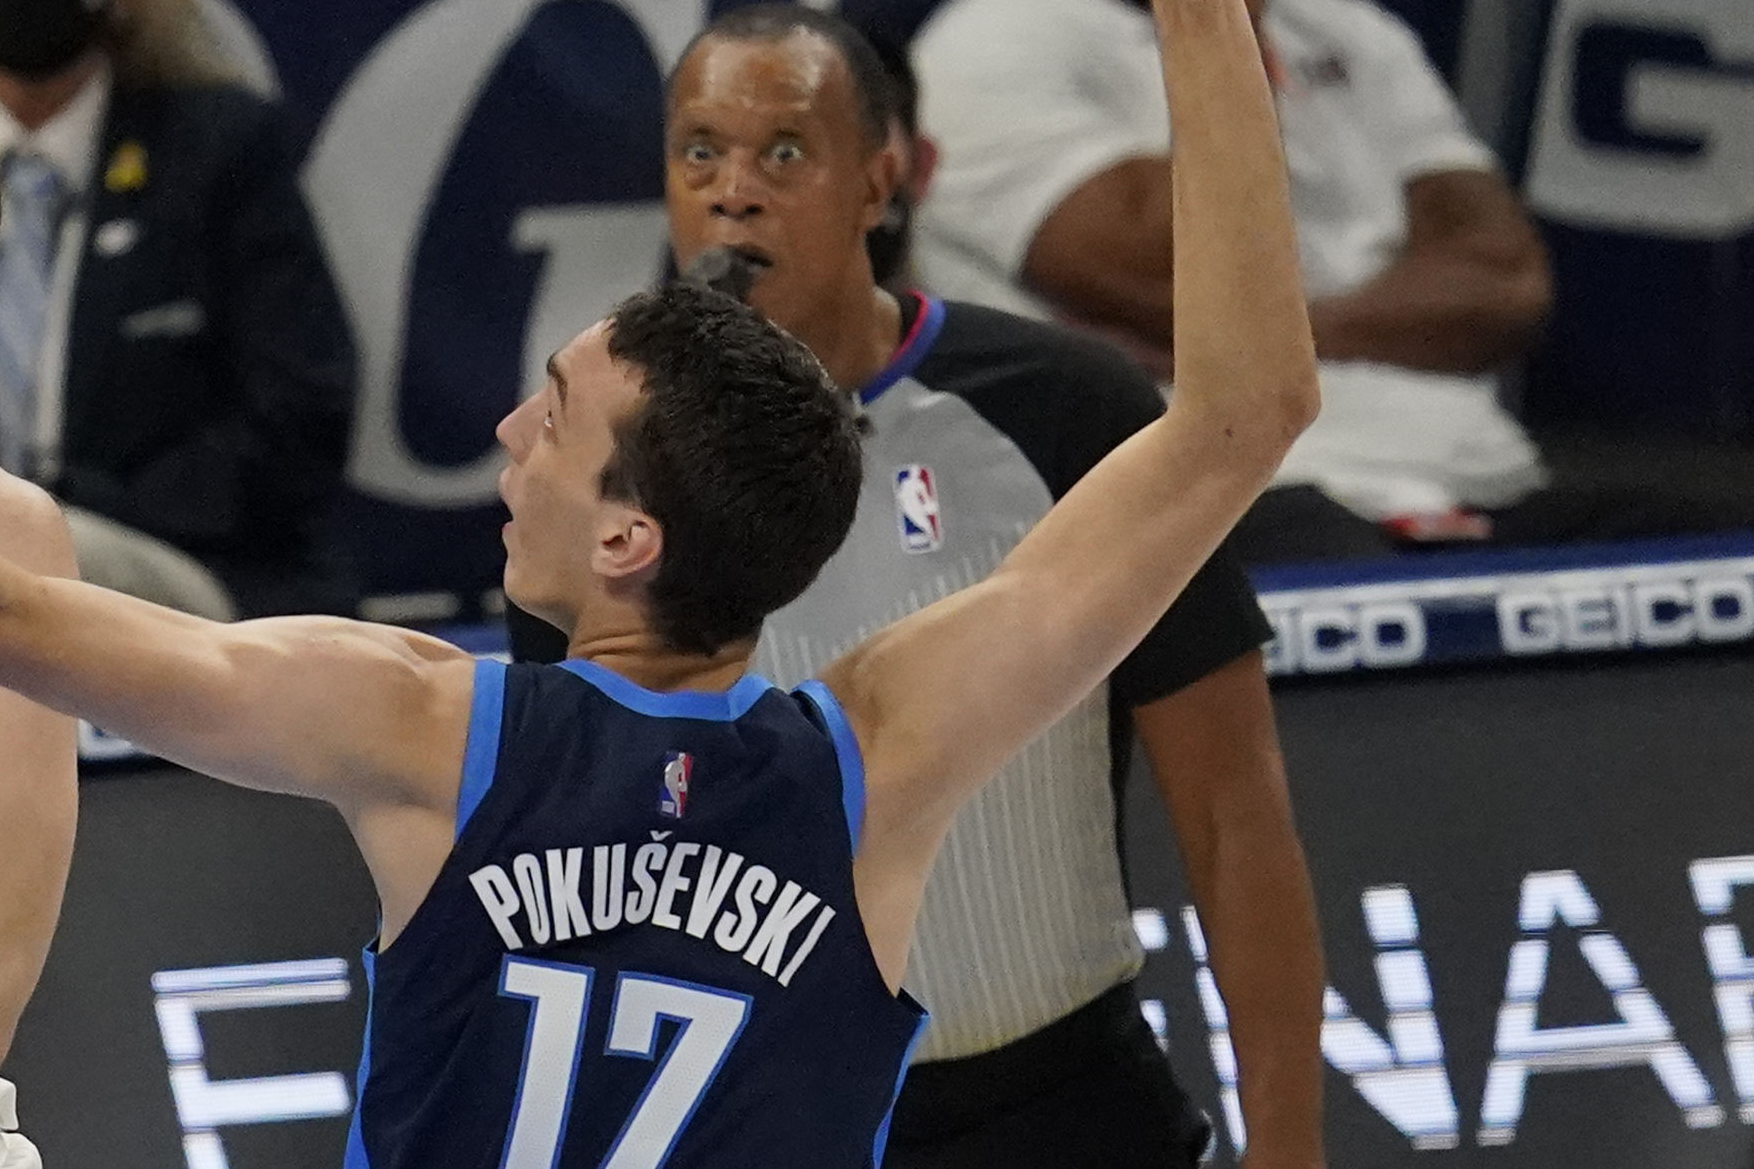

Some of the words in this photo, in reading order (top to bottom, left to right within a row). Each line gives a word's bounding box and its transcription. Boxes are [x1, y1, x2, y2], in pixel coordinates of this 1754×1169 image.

[1260, 602, 1428, 676] ICO
[1496, 578, 1754, 656] GEICO
[468, 830, 837, 988] POKUŠEVSKI
[497, 952, 754, 1169] 17
